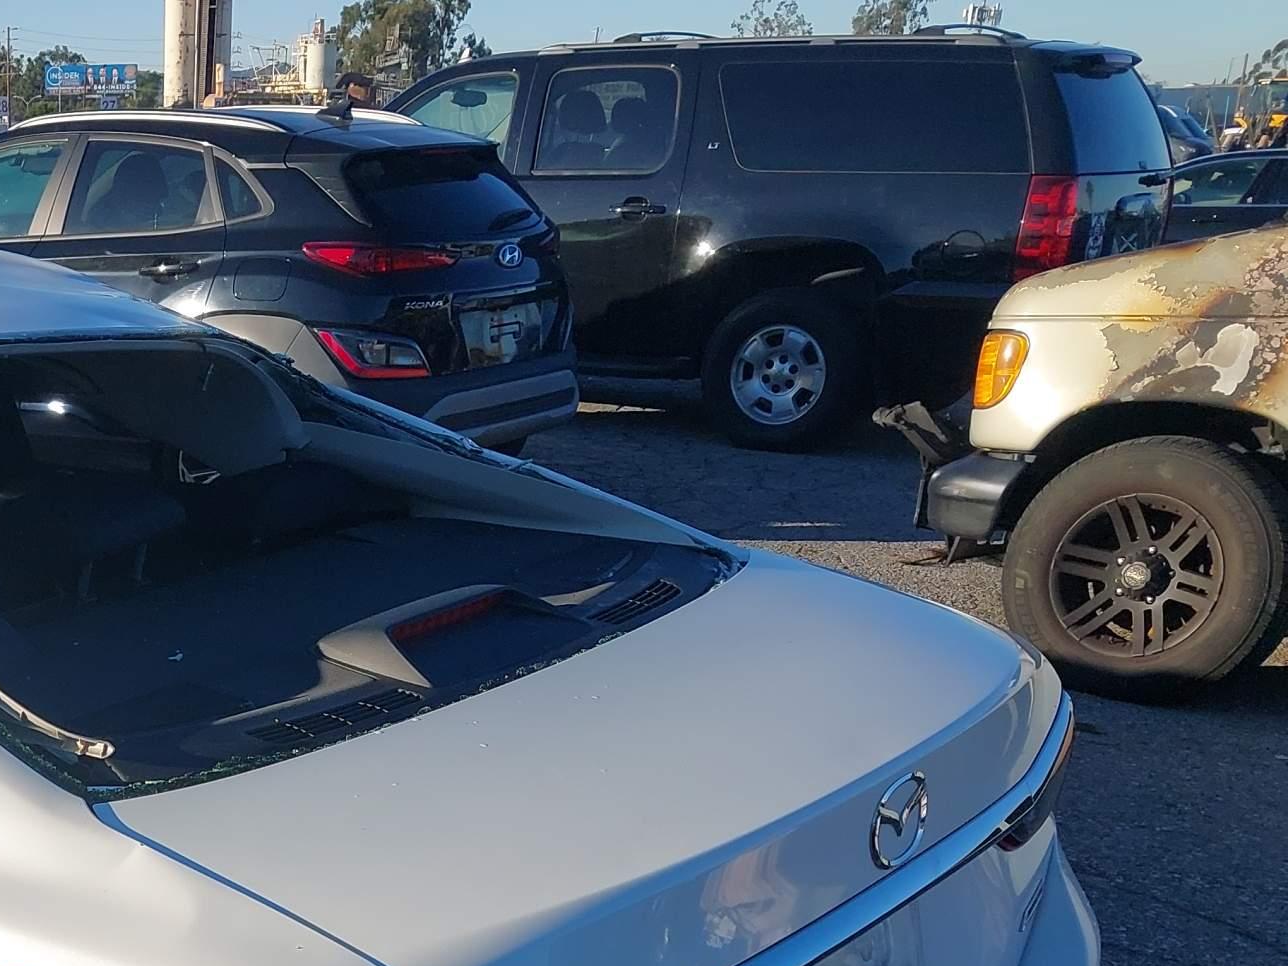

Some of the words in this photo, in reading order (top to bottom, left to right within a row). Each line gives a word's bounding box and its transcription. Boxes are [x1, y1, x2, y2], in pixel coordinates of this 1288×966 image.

[102, 100, 116, 109] 27
[707, 142, 721, 150] LT
[404, 300, 449, 310] KONA
